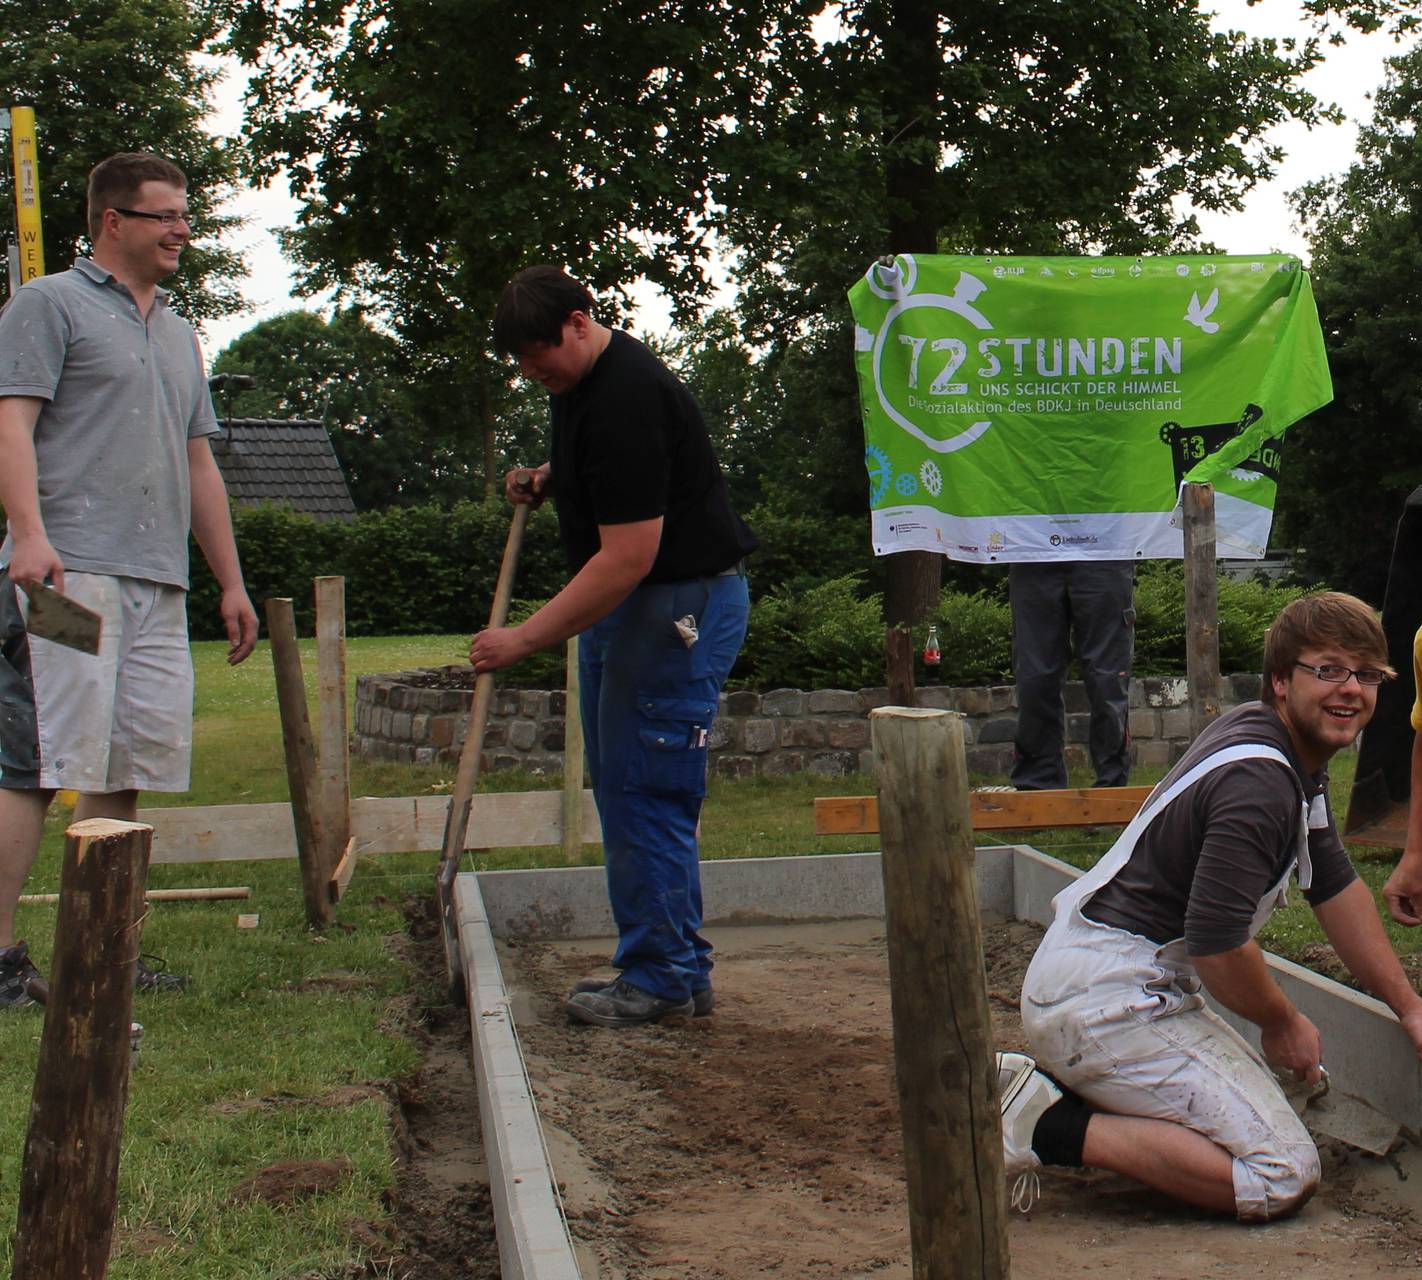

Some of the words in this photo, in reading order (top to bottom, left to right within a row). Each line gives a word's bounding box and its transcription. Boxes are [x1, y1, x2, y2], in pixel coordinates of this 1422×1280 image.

[898, 334, 968, 395] 72
[978, 336, 1182, 377] STUNDEN
[980, 383, 1009, 396] UNS
[1016, 382, 1081, 396] SCHICKT
[1087, 382, 1116, 394] DER
[1123, 381, 1182, 394] HIMMEL
[1008, 400, 1032, 412] des
[1037, 399, 1072, 412] BDKJ
[1078, 400, 1090, 411] in
[1096, 398, 1182, 411] Deutschland
